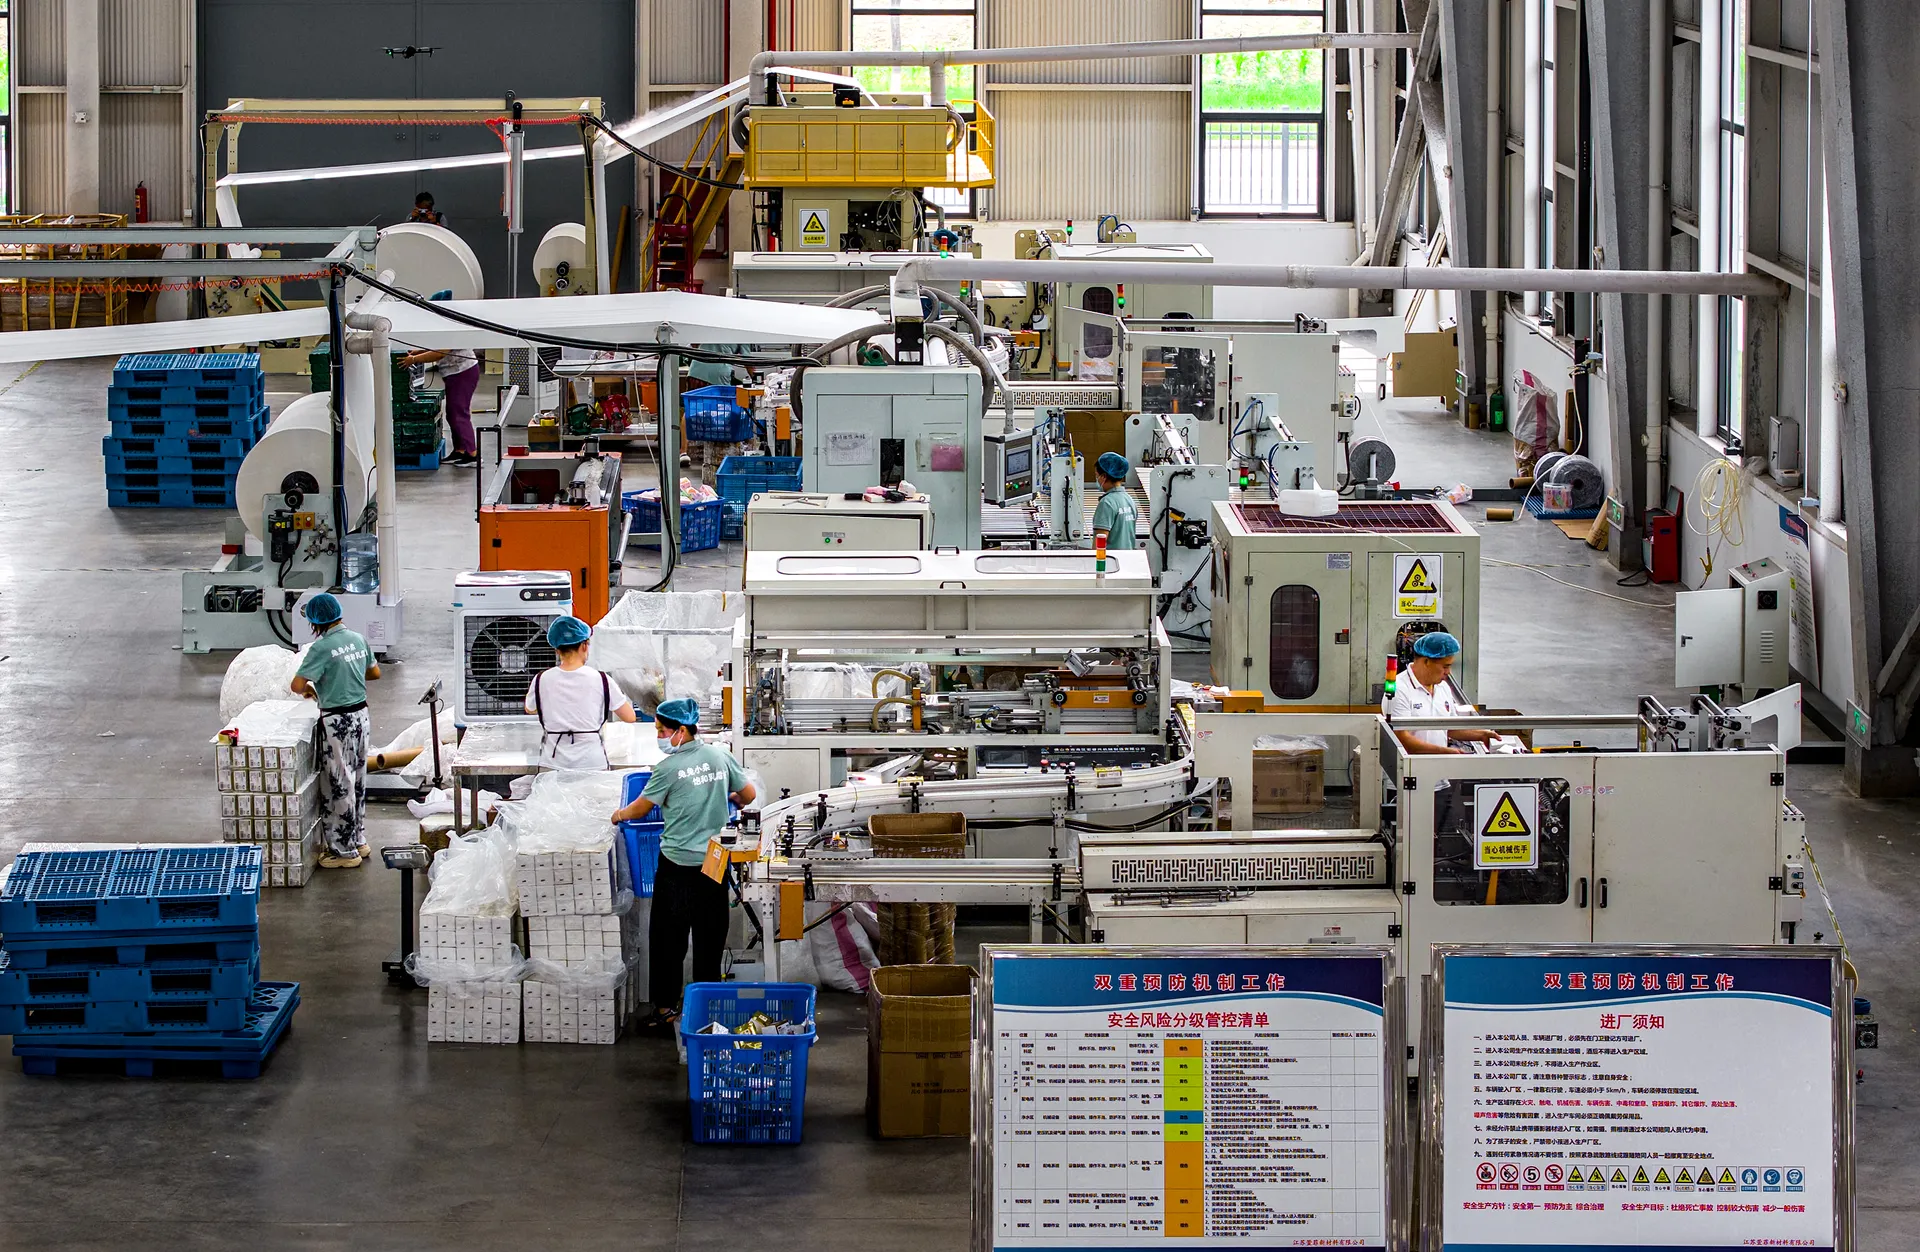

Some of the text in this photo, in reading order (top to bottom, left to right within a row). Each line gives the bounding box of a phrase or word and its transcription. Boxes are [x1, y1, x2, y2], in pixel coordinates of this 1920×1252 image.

[1484, 845, 1528, 854] 当心机械伤手
[1094, 973, 1286, 992] 双重预防机制工作
[1543, 972, 1735, 991] 双重预防机制工作
[1107, 1011, 1270, 1029] 安全风险分级管控清单
[1600, 1014, 1666, 1030] 进厂须知
